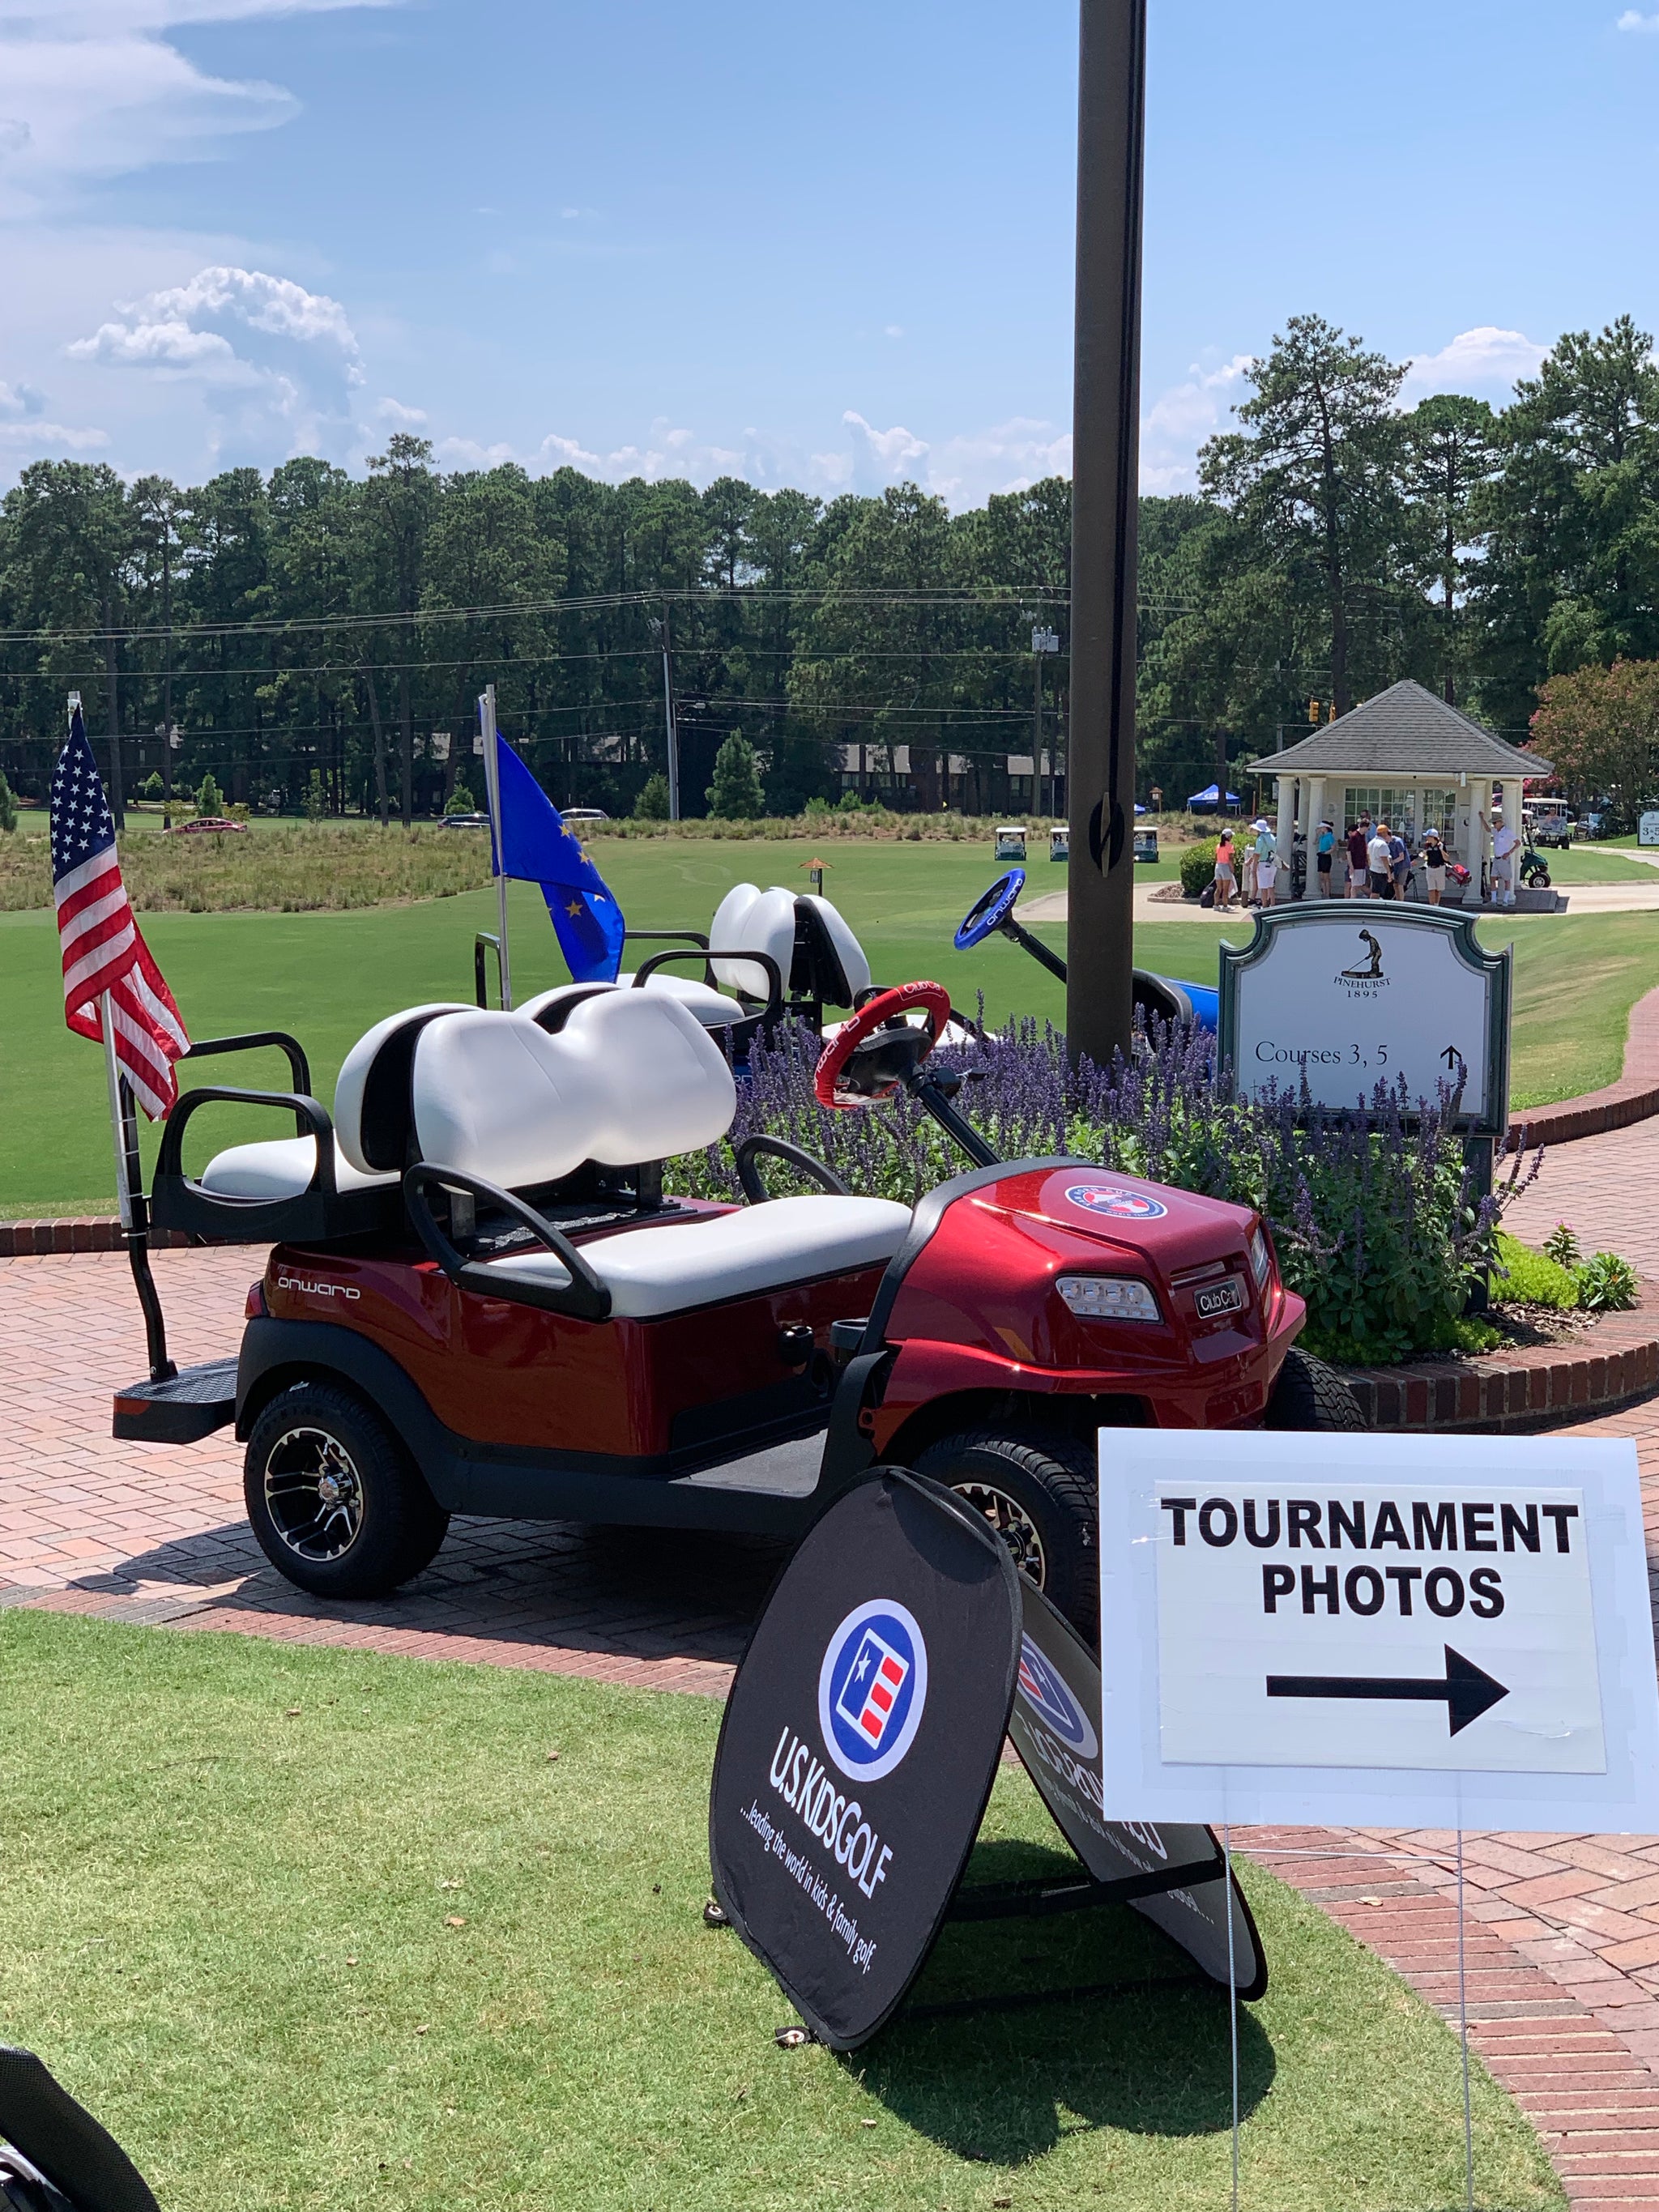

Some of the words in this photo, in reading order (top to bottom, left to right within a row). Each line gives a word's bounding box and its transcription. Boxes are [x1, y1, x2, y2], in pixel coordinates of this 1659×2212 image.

[1643, 827, 1649, 836] 3
[1333, 976, 1391, 989] PINEHURST
[1347, 990, 1378, 999] 1895
[1255, 1041, 1341, 1064] Courses
[1347, 1043, 1367, 1068] 3,
[1376, 1044, 1388, 1066] 5
[1160, 1498, 1579, 1554] TOURNAMENT
[1262, 1564, 1505, 1619] PHOTOS
[772, 1830, 787, 1860] the
[784, 1848, 808, 1884] world
[803, 1865, 812, 1894] in
[810, 1873, 828, 1912] kids
[826, 1894, 838, 1922] &
[830, 1902, 859, 1955] family
[852, 1940, 876, 1975] golf.
